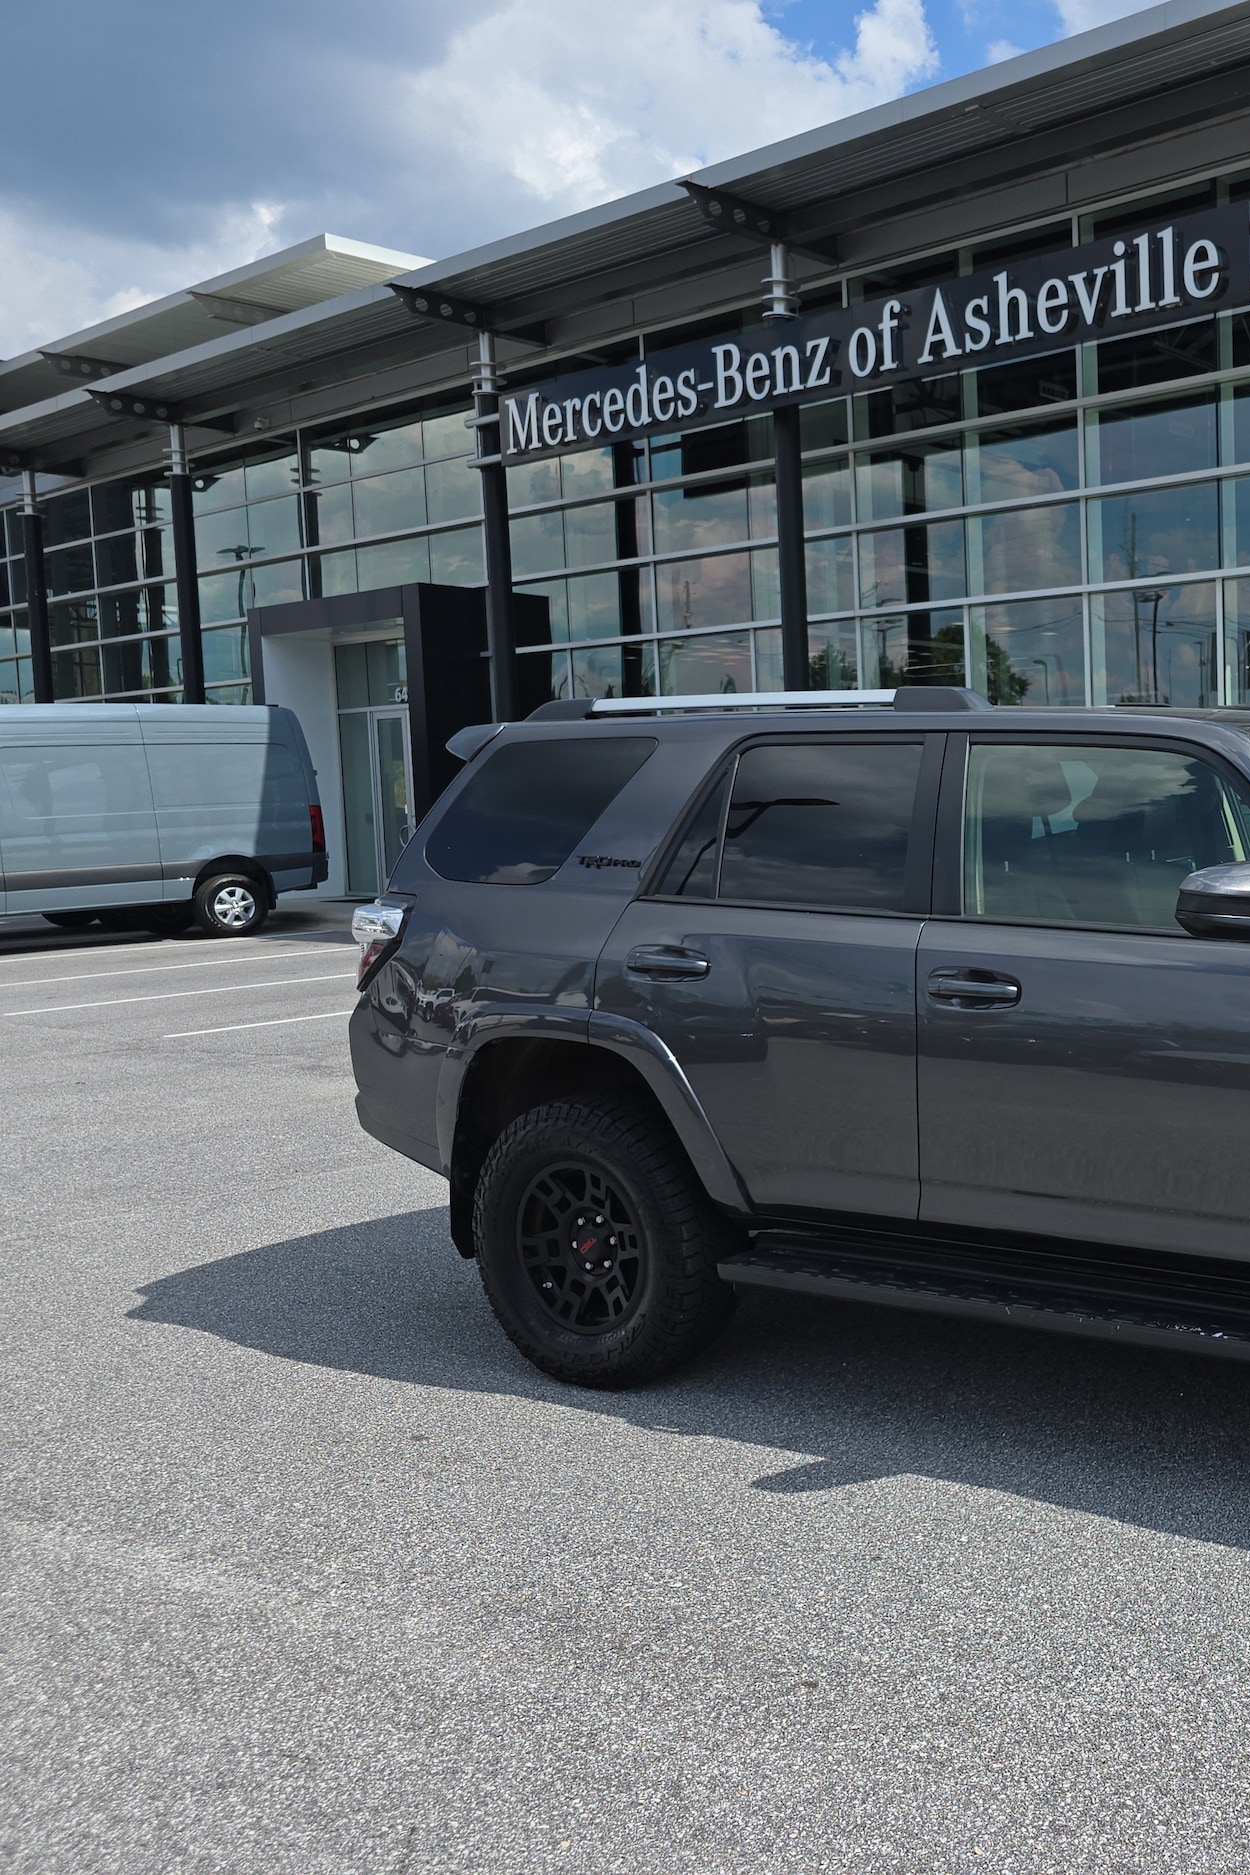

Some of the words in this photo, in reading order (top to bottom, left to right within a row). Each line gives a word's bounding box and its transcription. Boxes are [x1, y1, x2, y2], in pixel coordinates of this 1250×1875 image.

[505, 336, 831, 456] Mercedes-Benz
[848, 299, 902, 378] of
[917, 226, 1222, 363] Asheville
